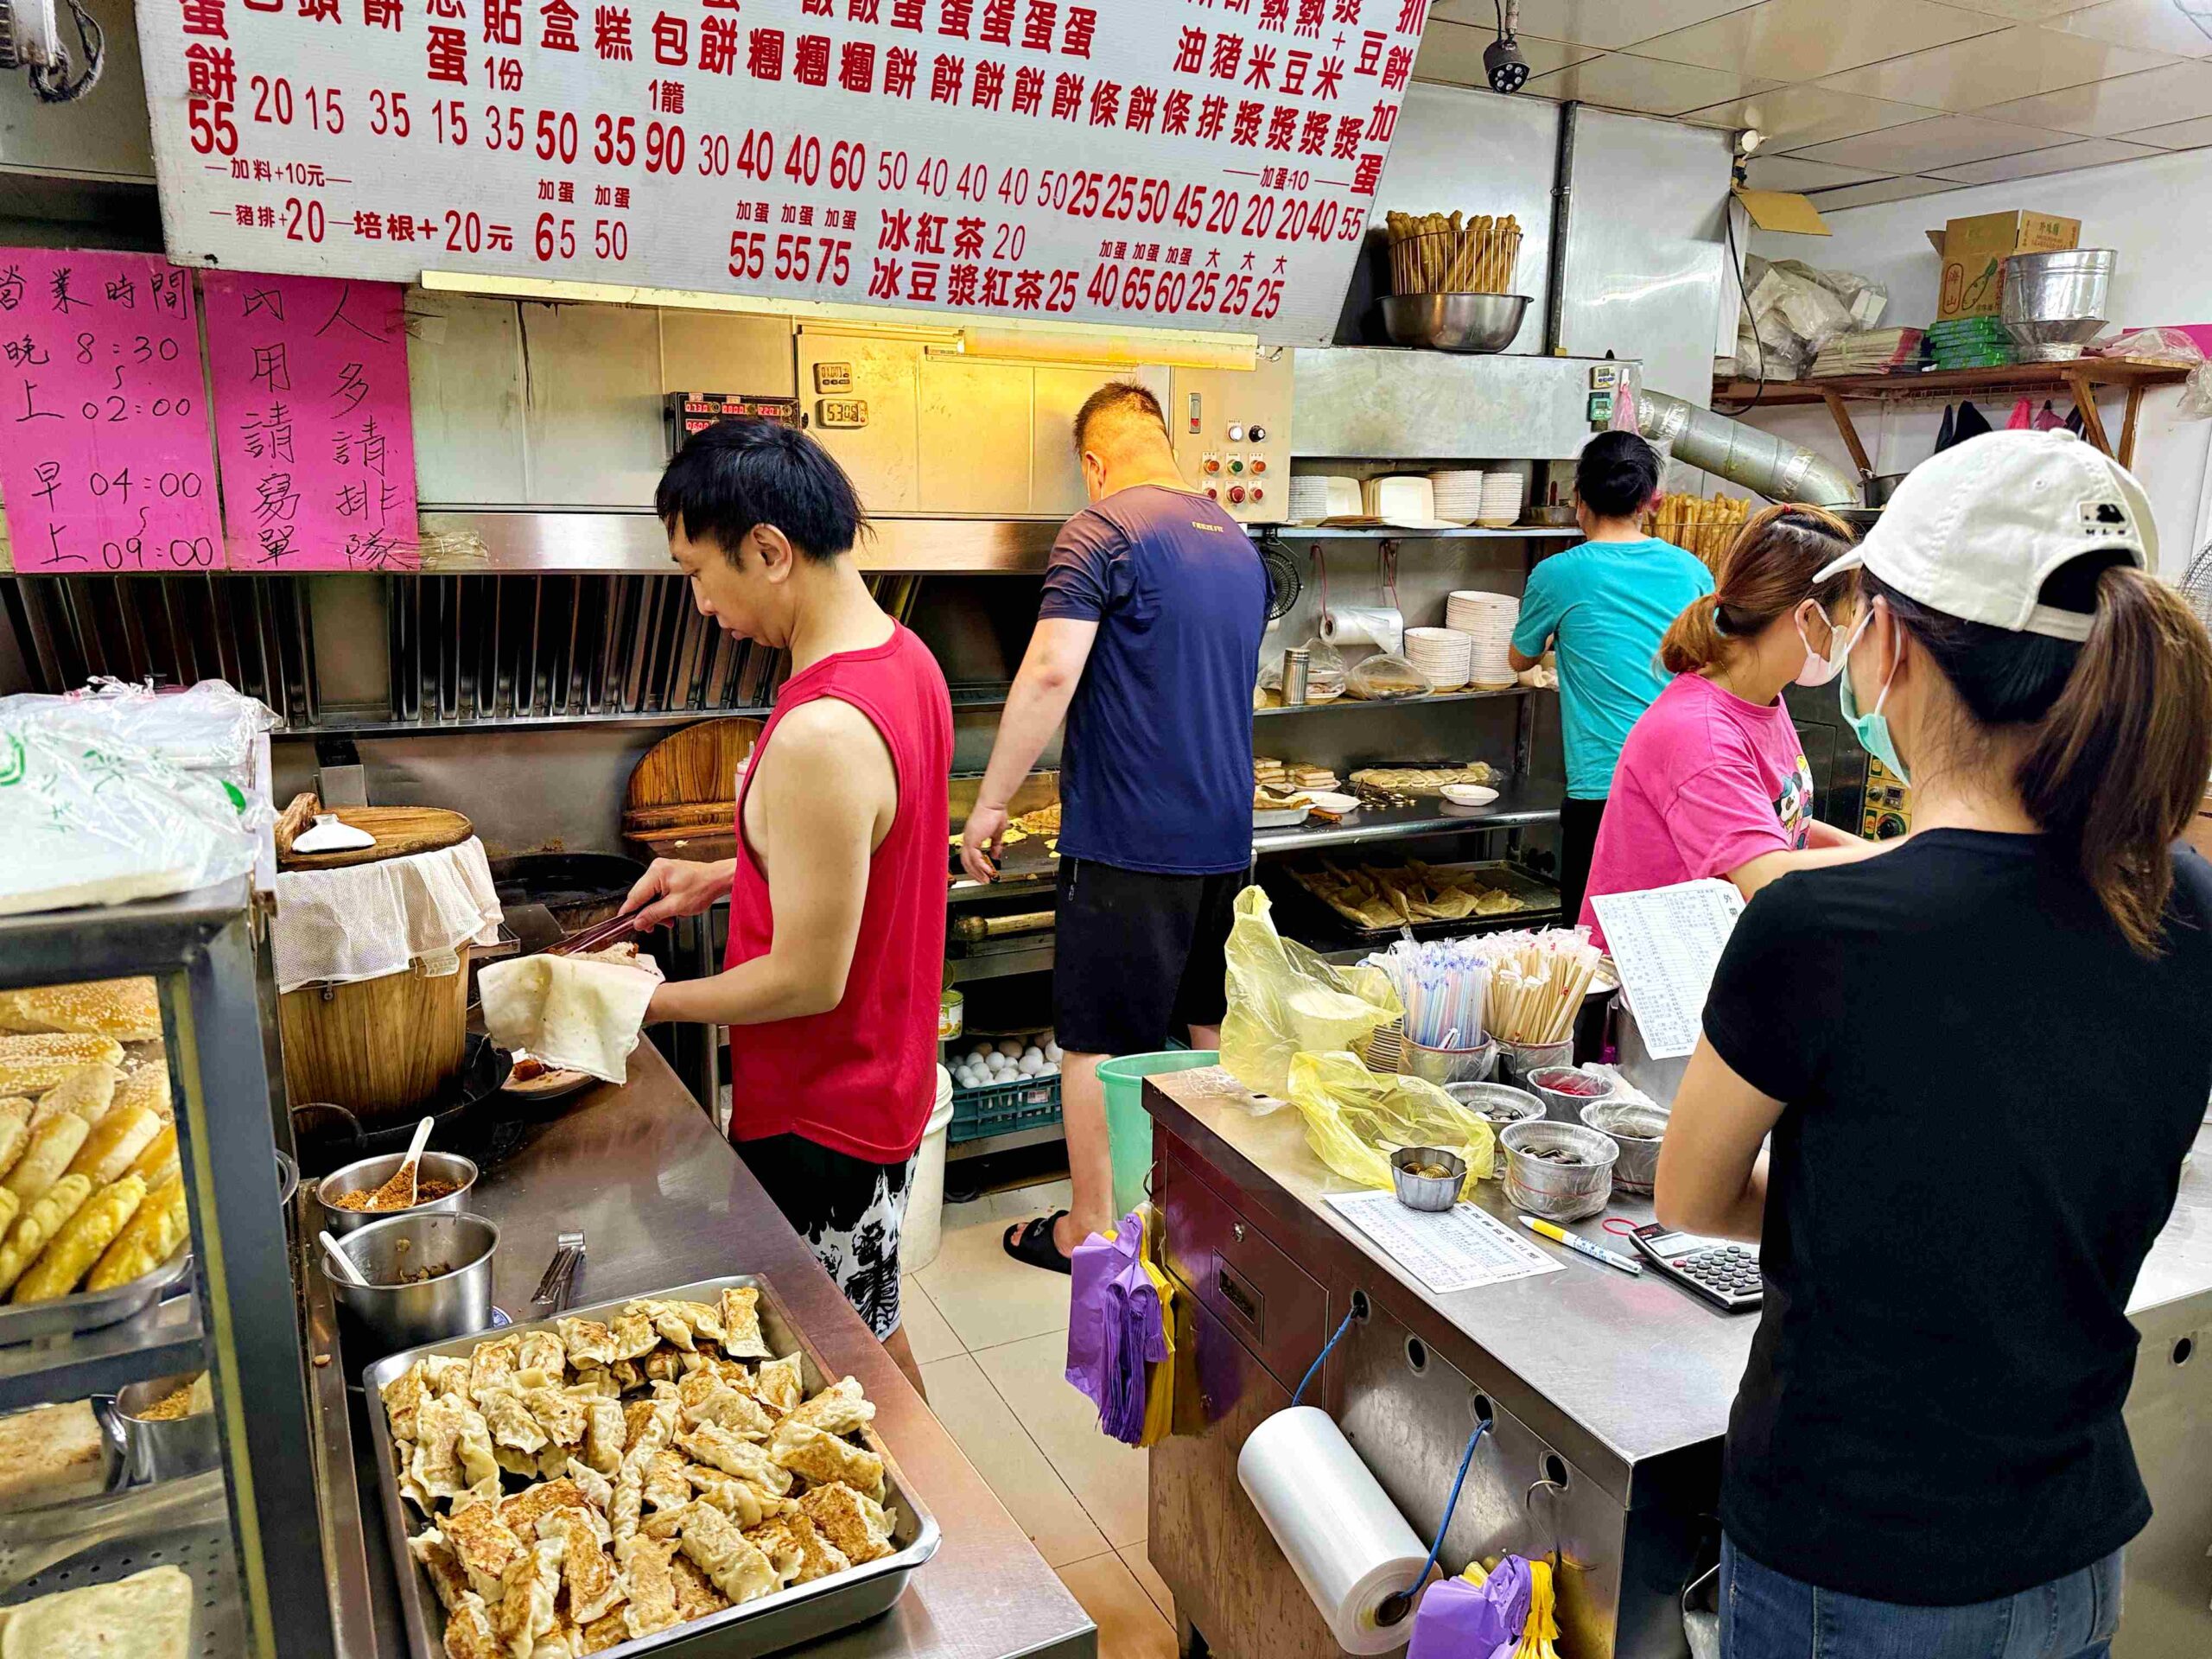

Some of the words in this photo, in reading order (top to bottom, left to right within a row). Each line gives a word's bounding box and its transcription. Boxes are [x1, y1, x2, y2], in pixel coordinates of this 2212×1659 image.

[484, 0, 522, 45] 貼
[540, 0, 579, 52] 盒
[594, 5, 632, 61] 糕
[652, 11, 688, 66] 包
[698, 0, 740, 75] 餅
[485, 57, 523, 92] 1份
[931, 0, 973, 105] 蛋餅
[972, 0, 1016, 111] 蛋餅
[1012, 0, 1057, 116] 蛋餅
[1052, 7, 1096, 122] 蛋餅
[1161, 0, 1212, 135] 油條
[1196, 0, 1249, 139] 豬排
[251, 75, 292, 124] 20
[306, 87, 344, 134] 15
[370, 90, 410, 137] 35
[649, 79, 683, 114] 1籠
[1090, 80, 1122, 127] 條
[1126, 86, 1158, 133] 餅
[188, 98, 238, 156] 55
[432, 100, 467, 145] 15
[486, 106, 524, 150] 35
[536, 111, 577, 164] 50
[594, 114, 635, 166] 35
[645, 122, 684, 175] 90
[699, 135, 728, 175] 30
[737, 129, 773, 181] 40
[785, 135, 820, 186] 40
[830, 141, 865, 191] 60
[879, 152, 907, 190] 50
[538, 181, 574, 202] 加蛋
[594, 186, 629, 208] 加蛋
[917, 159, 948, 197] 40
[957, 163, 987, 202] 40
[998, 168, 1028, 206] 40
[1038, 170, 1067, 210] 50
[1067, 170, 1103, 218] 25
[1102, 174, 1138, 220] 25
[736, 201, 769, 222] 加蛋
[781, 205, 813, 226] 加蛋
[825, 209, 856, 230] 加蛋
[1137, 179, 1169, 224] 50
[1173, 184, 1206, 228] 45
[1206, 190, 1238, 234] 20
[1242, 194, 1274, 238] 20
[1275, 199, 1308, 241] 20
[1306, 200, 1338, 242] 40
[1338, 207, 1365, 240] 55
[536, 213, 575, 261] 65
[595, 220, 627, 260] 50
[728, 231, 766, 279] 55
[878, 208, 986, 260] 冰紅茶
[993, 224, 1025, 261] 20
[1100, 241, 1127, 260] 加蛋
[1132, 244, 1159, 262] 加蛋
[1167, 248, 1192, 265] 加蛋
[775, 234, 811, 281] 55
[817, 238, 851, 286] 75
[1205, 247, 1221, 268] 大
[1239, 251, 1255, 271] 大
[1272, 255, 1287, 275] 大
[0, 265, 188, 320] 營業時間
[868, 257, 1045, 310] 冰豆漿紅茶
[1046, 270, 1079, 313] 25
[1087, 263, 1118, 307] 40
[1122, 267, 1154, 310] 65
[1154, 271, 1185, 314] 60
[1186, 270, 1220, 312] 25
[1219, 274, 1253, 315] 25
[1251, 278, 1285, 319] 25
[76, 333, 179, 365] 8:30
[81, 395, 191, 422] 02:00
[240, 288, 301, 567] 內用請寫單
[314, 283, 413, 569] 人多請排隊
[32, 461, 88, 564] 早上
[90, 467, 201, 505] 04:00
[103, 537, 213, 569] 09:00
